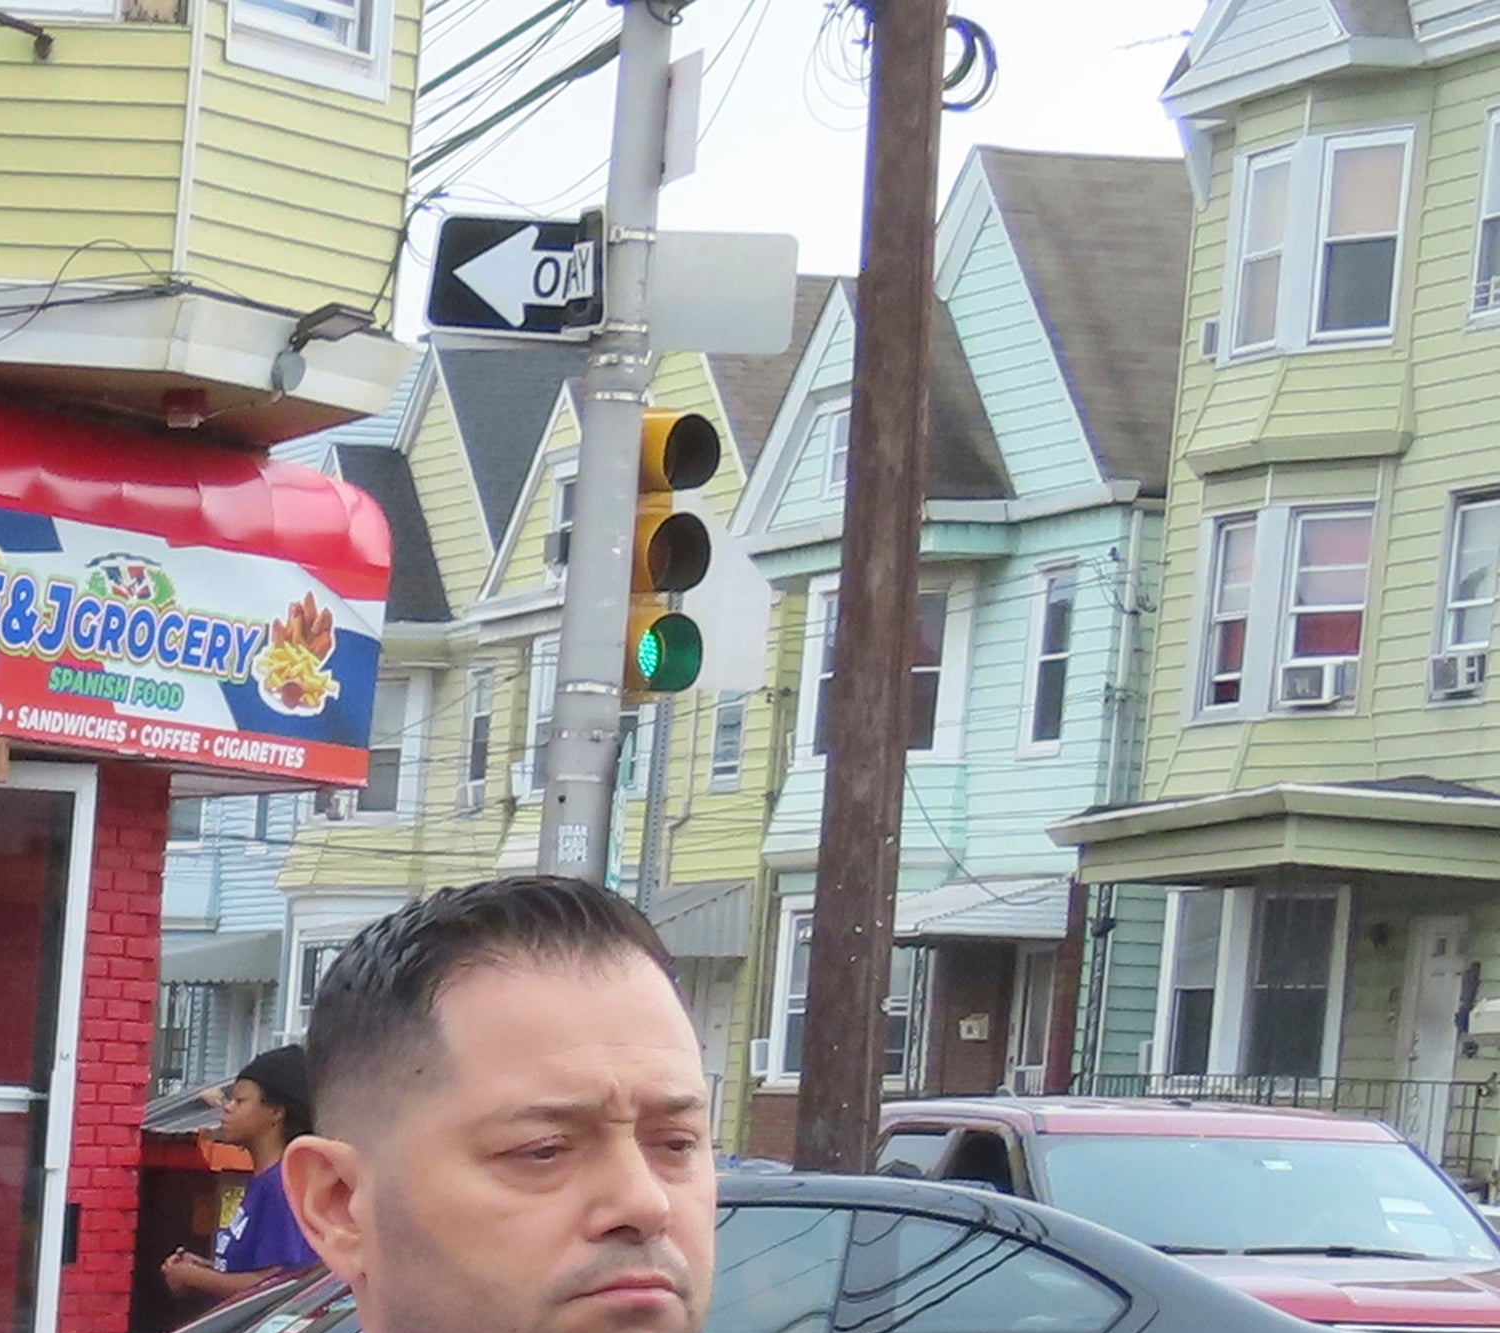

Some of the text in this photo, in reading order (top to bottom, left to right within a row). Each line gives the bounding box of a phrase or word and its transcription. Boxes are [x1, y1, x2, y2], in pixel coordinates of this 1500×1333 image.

[49, 668, 185, 711] SPANISH FOOD
[17, 705, 127, 743] SANDWICHES
[140, 725, 201, 754] COFFEE
[212, 735, 306, 769] CIGARETTES
